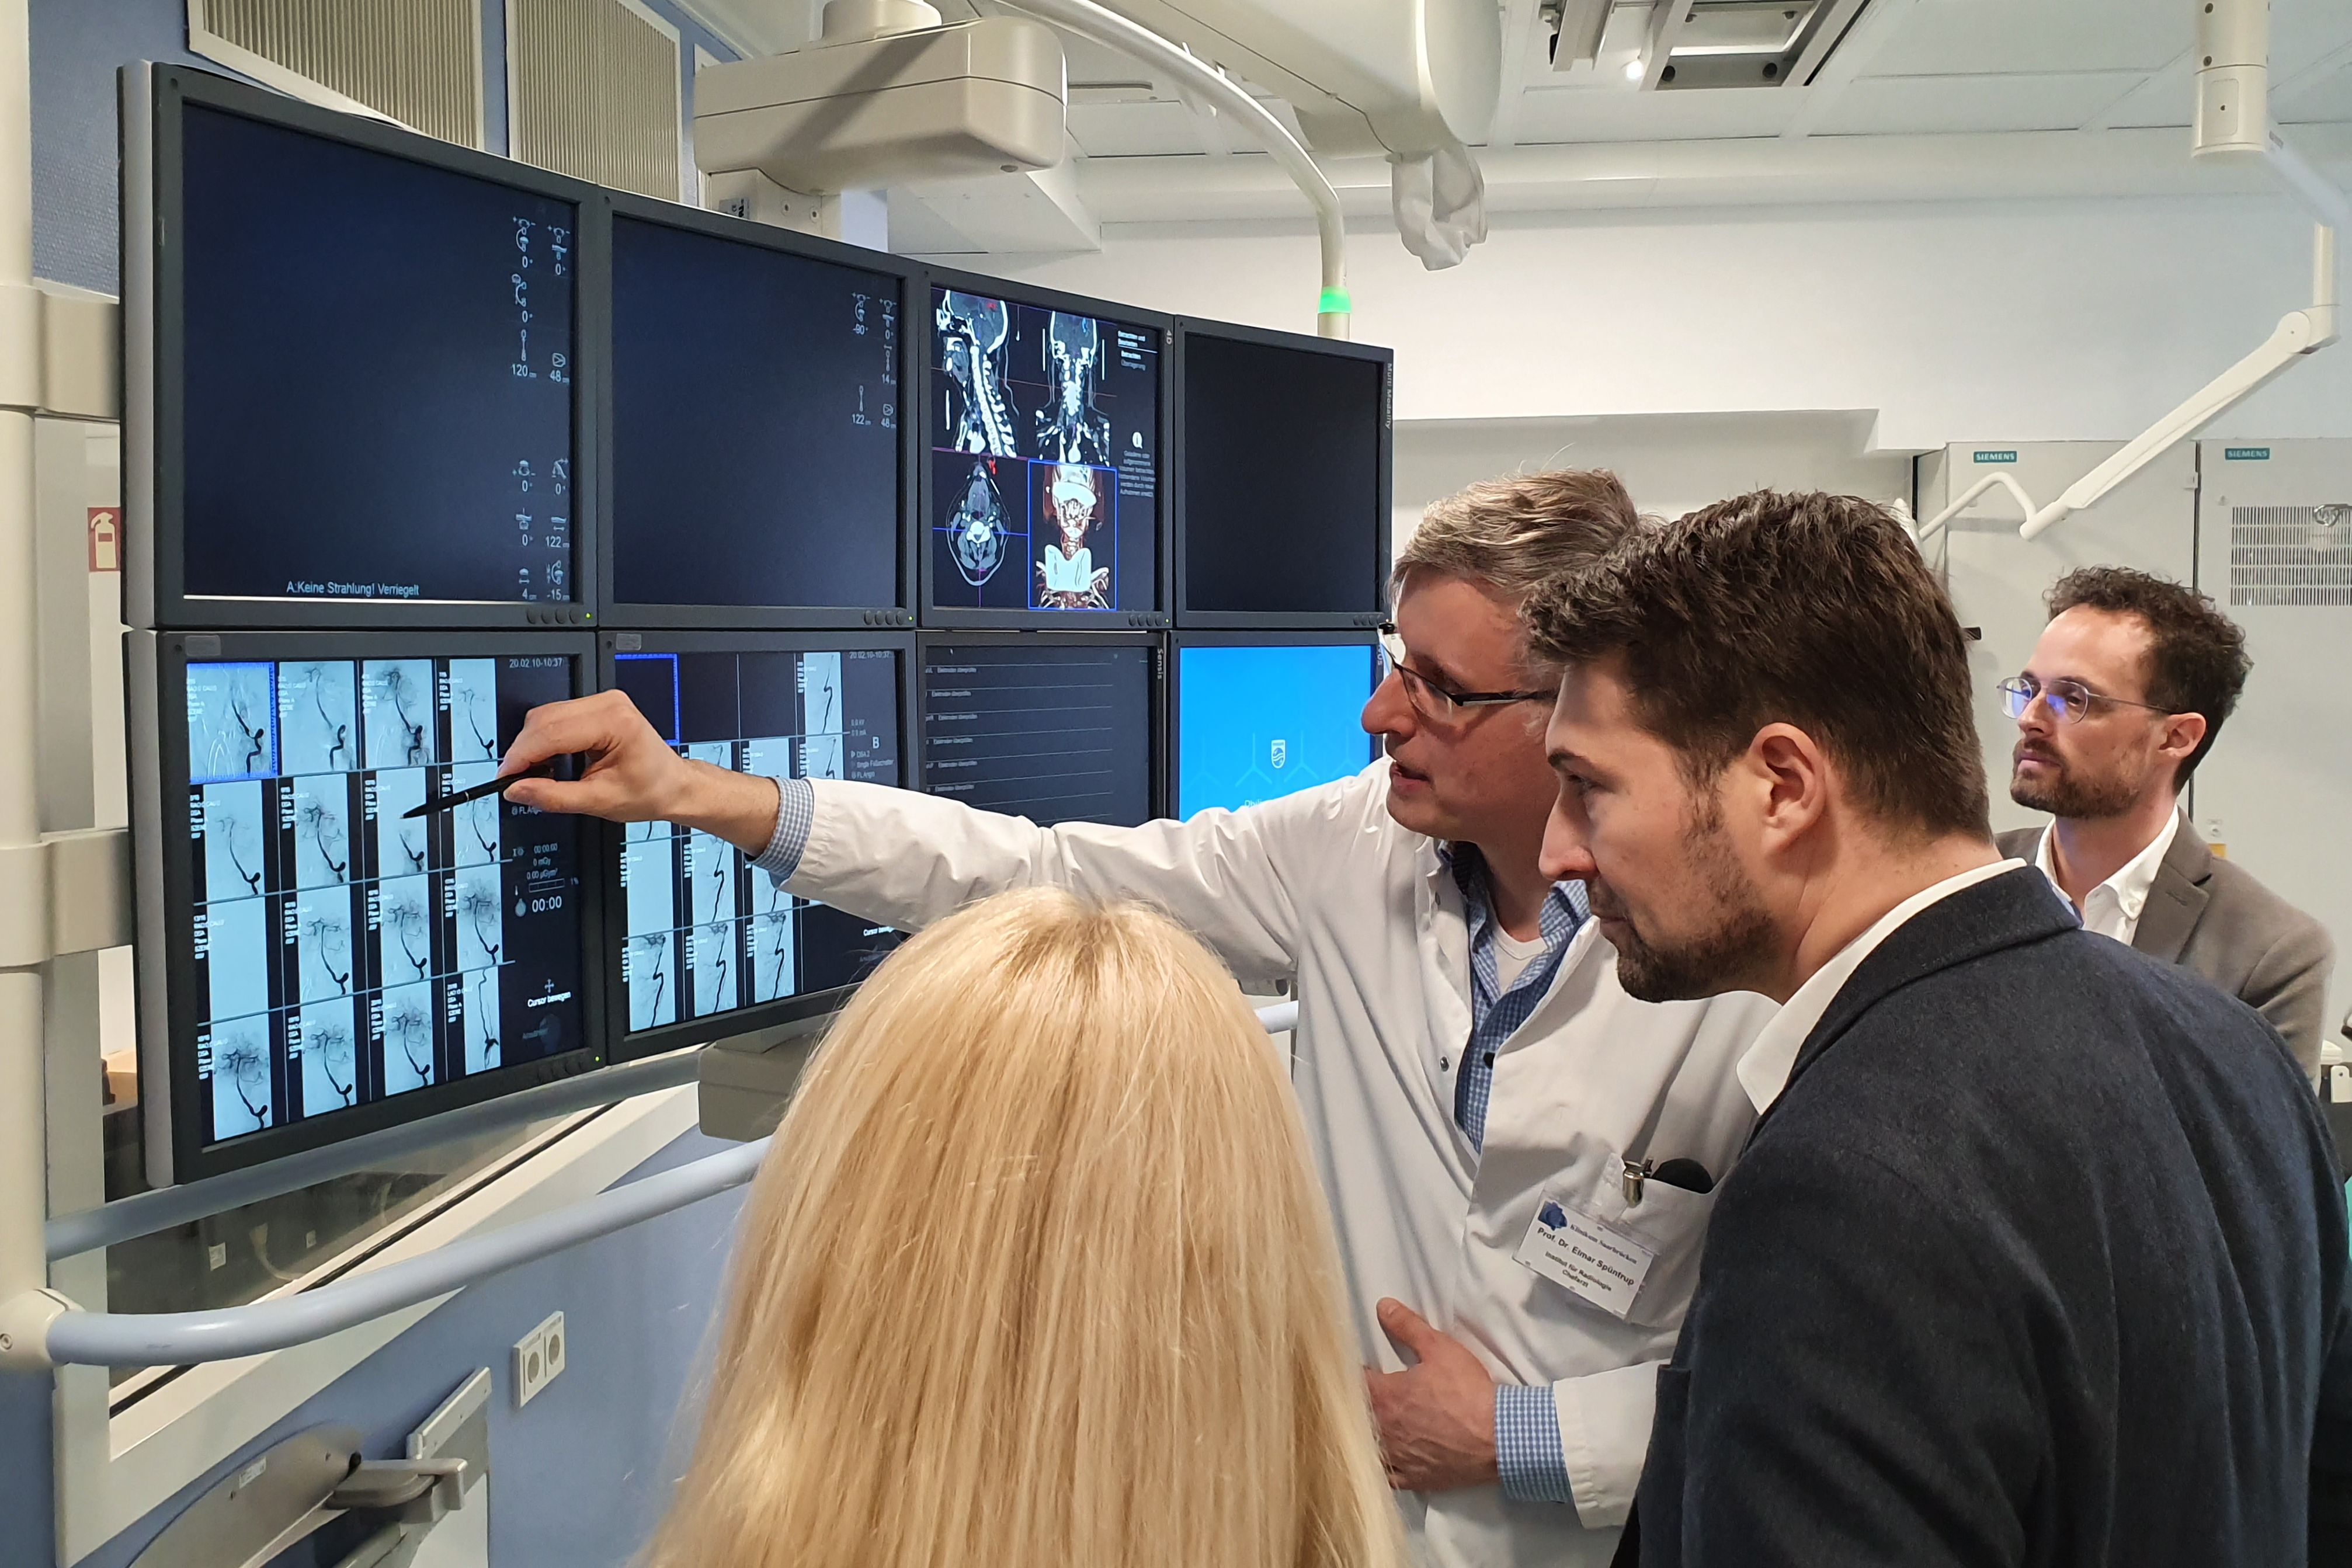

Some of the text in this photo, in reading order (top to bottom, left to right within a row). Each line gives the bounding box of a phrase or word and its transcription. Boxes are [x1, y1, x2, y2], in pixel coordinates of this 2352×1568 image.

[512, 364, 528, 377] 120
[550, 370, 561, 382] 48
[852, 414, 864, 425] 122
[881, 418, 890, 428] 48
[546, 536, 561, 548] 122
[377, 583, 419, 598] Verriegelt
[522, 588, 528, 600] 4
[547, 588, 561, 600] -15
[873, 736, 880, 749] B
[532, 896, 562, 912] 00:00
[1537, 1227, 1634, 1287] Prof. Dr. Elmar Spüntrup
[1545, 1251, 1612, 1292] Institut für Radiologie
[1562, 1269, 1589, 1288] Chefarzt
